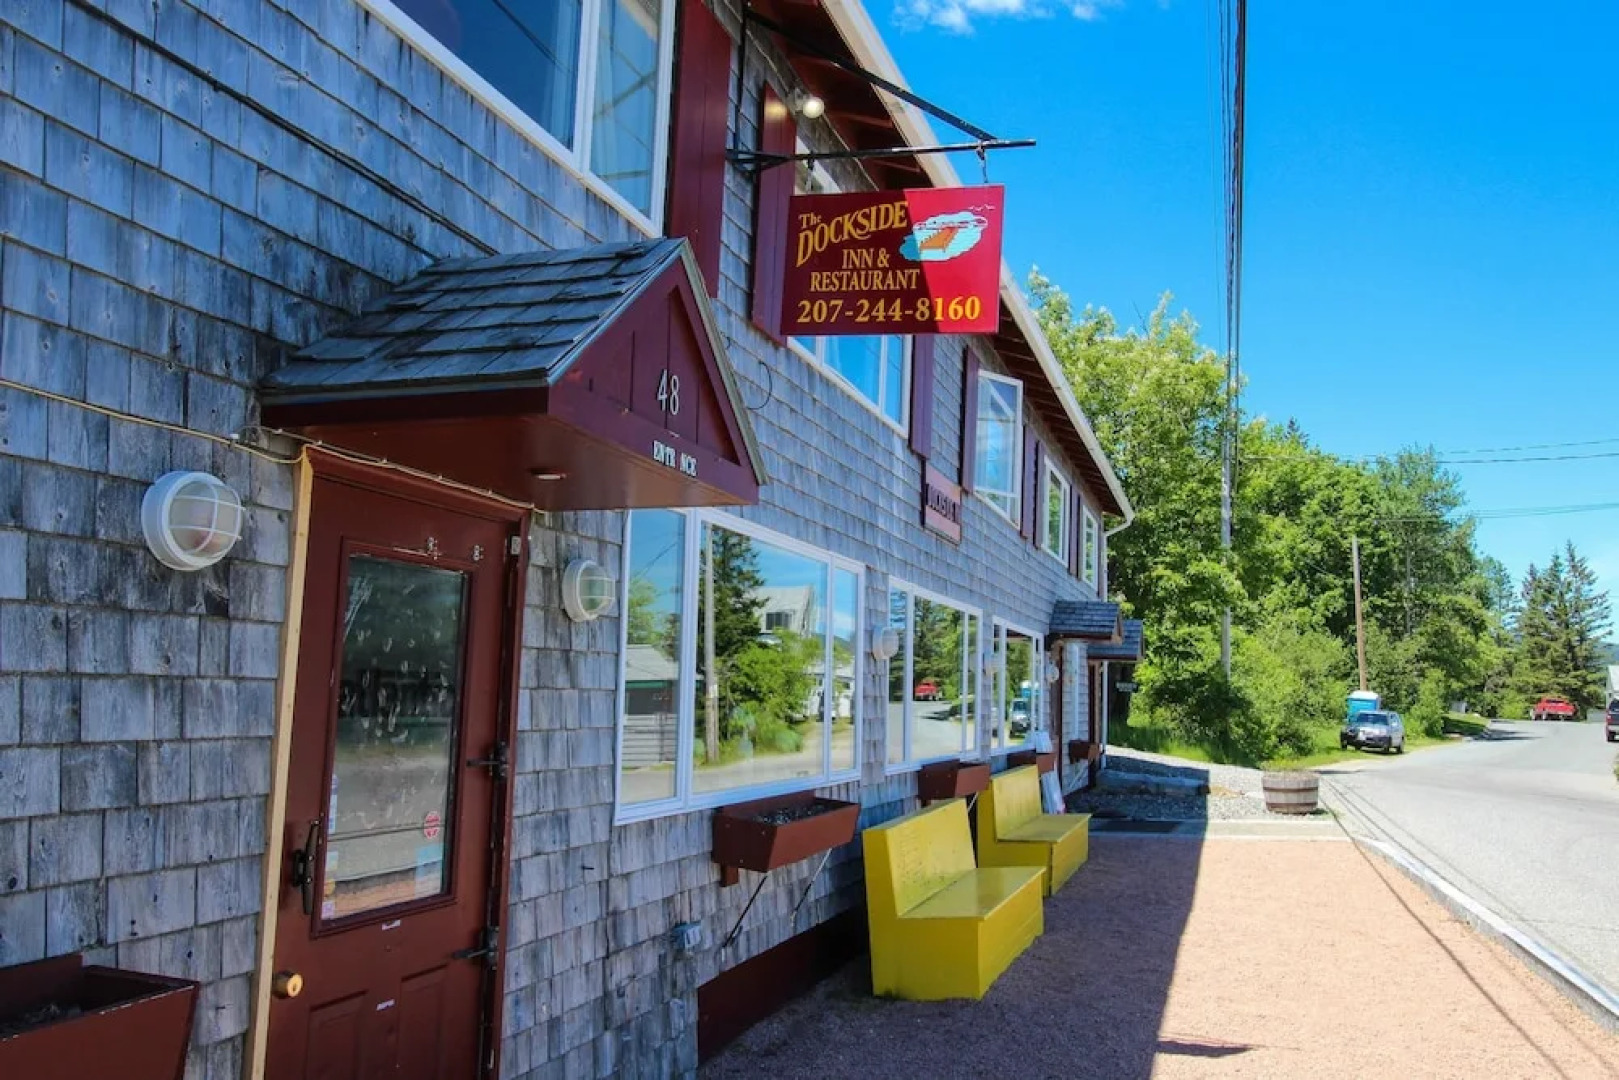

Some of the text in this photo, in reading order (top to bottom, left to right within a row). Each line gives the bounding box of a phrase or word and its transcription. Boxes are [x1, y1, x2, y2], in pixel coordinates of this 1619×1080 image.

[796, 200, 909, 268] The DOCKSIDE
[842, 247, 890, 270] INN &
[810, 268, 920, 292] RESTAURANT
[797, 296, 981, 323] 207-244-8160
[657, 369, 680, 415] 48
